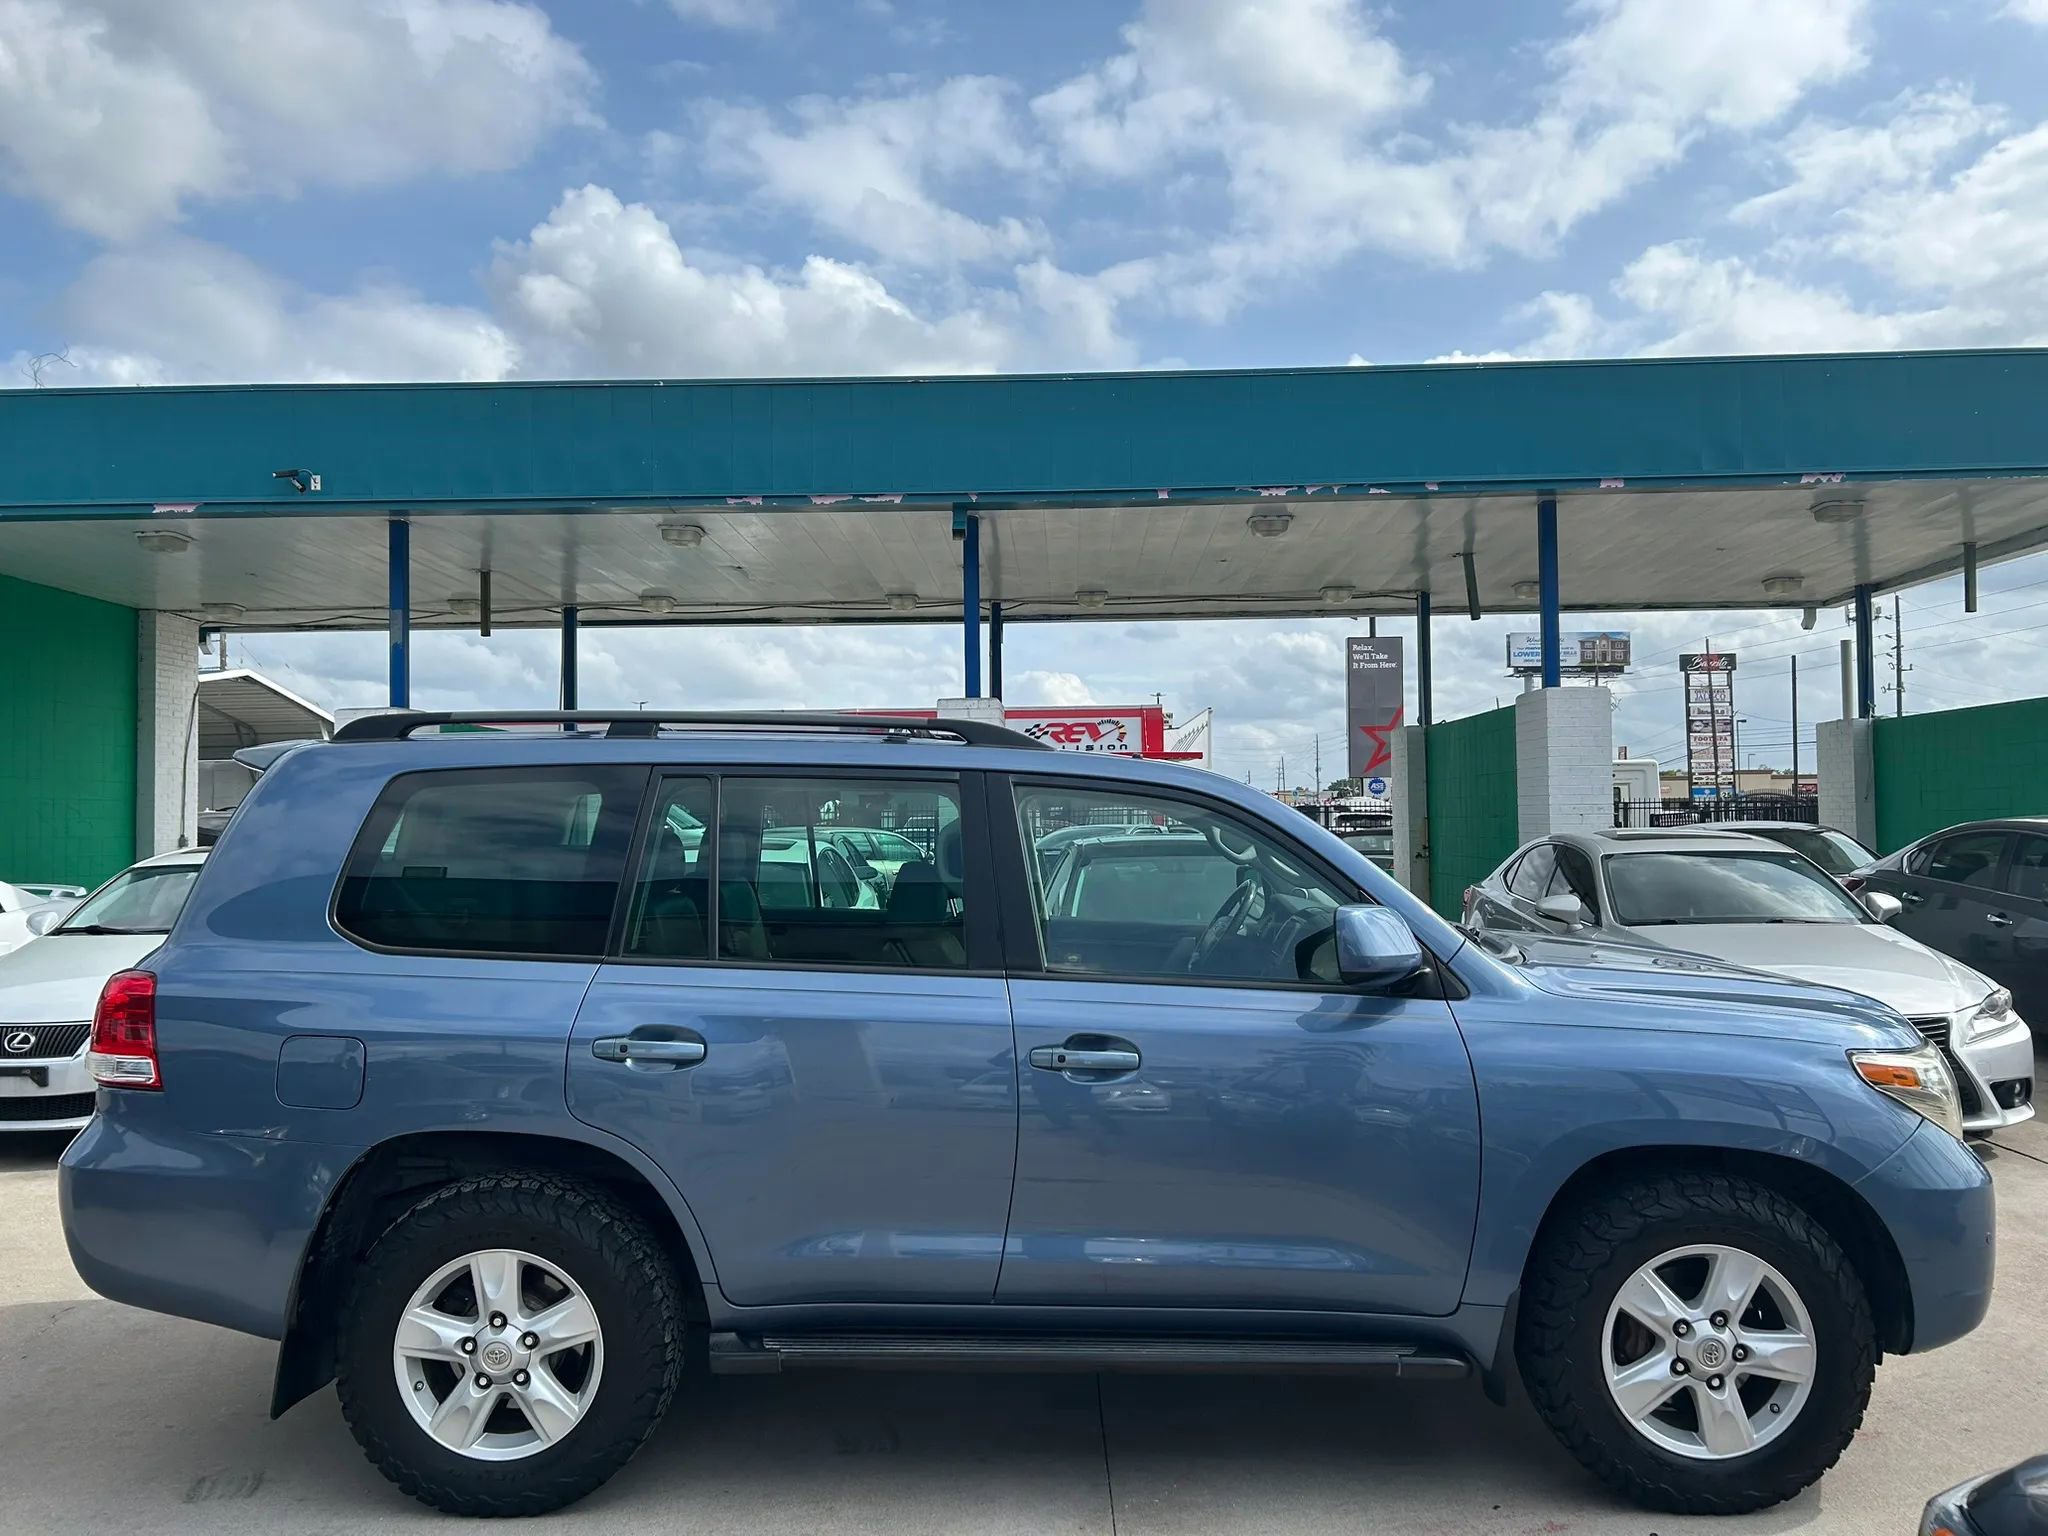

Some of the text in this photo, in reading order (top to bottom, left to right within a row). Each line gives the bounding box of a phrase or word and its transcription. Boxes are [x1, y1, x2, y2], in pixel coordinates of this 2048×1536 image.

[1352, 644, 1374, 652] Relax,
[1695, 692, 1726, 701] JALCO
[1039, 722, 1102, 744] REV
[1370, 782, 1384, 791] ASE
